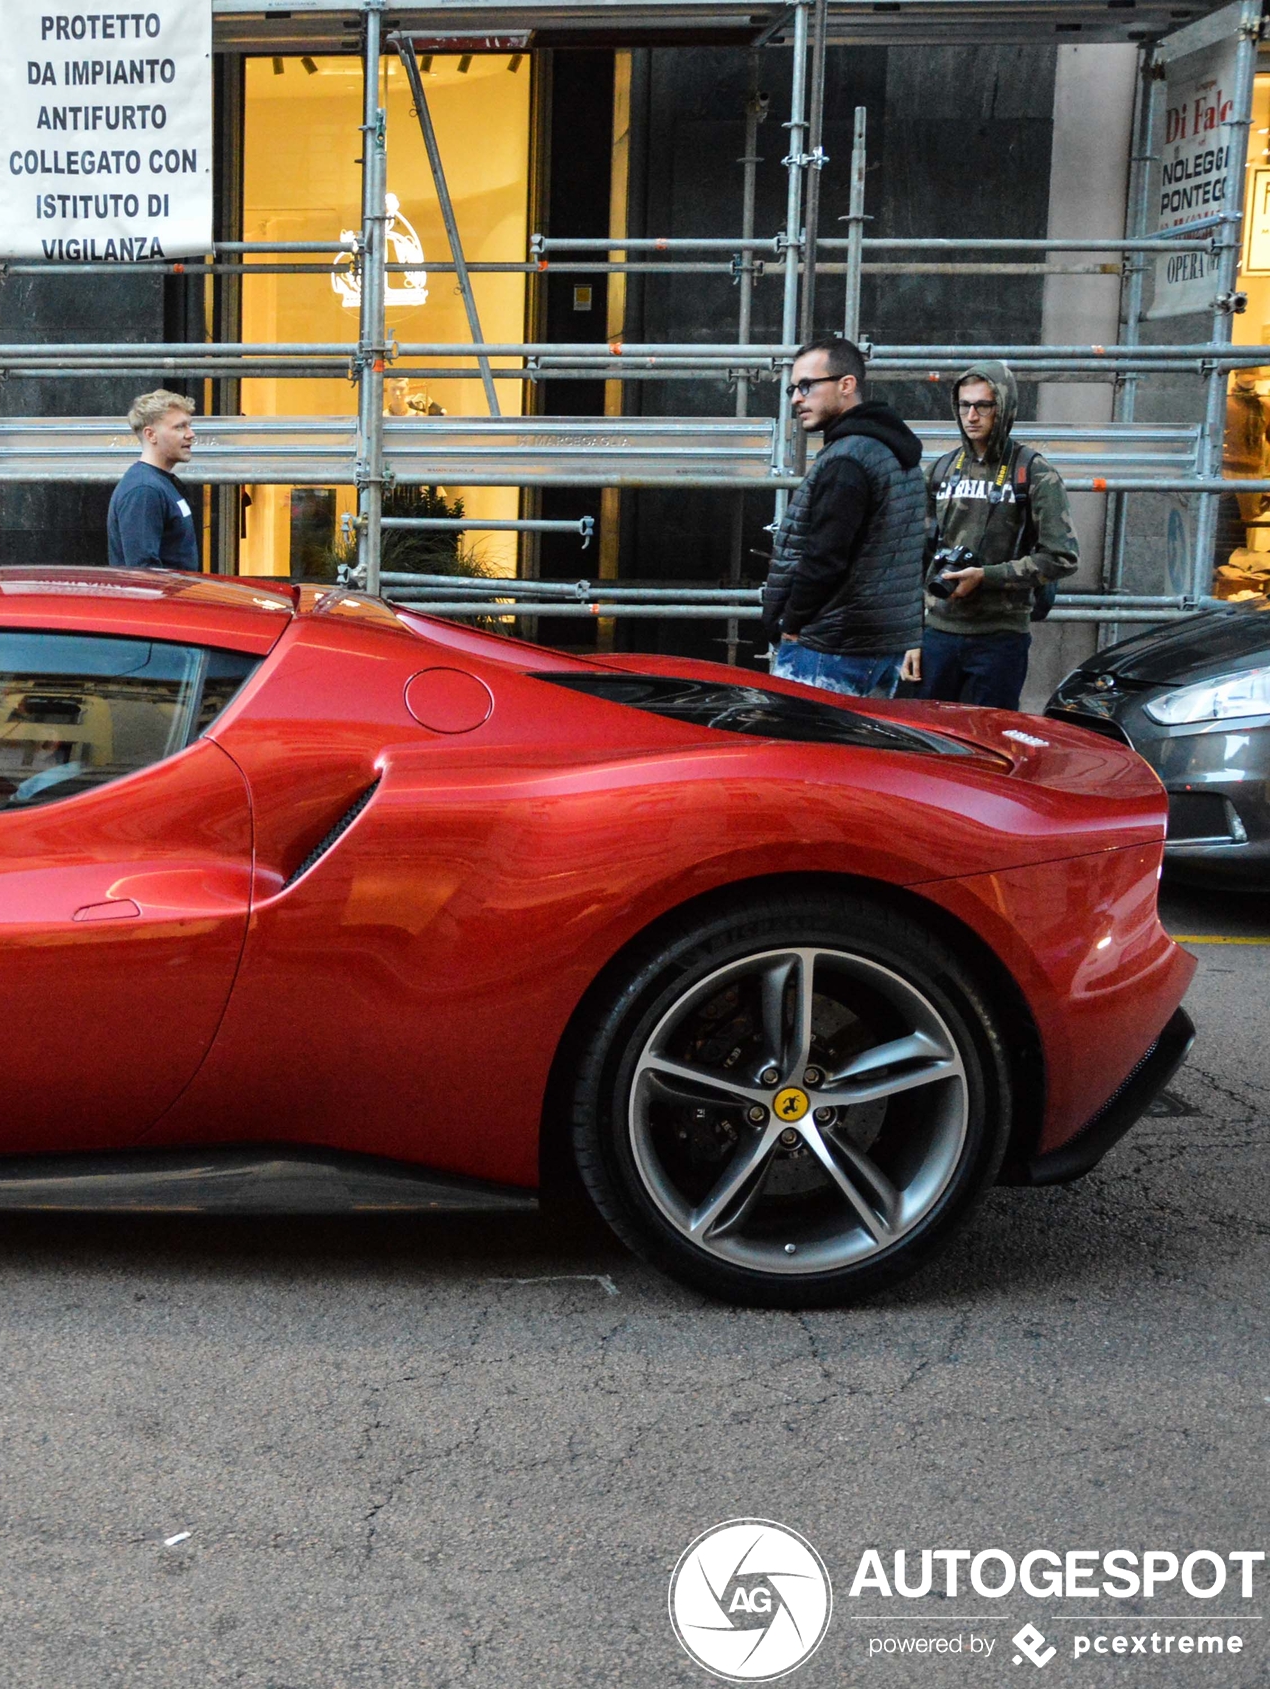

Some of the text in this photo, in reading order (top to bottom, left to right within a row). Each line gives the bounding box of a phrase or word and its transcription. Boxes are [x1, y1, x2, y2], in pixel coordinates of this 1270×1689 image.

[41, 13, 161, 41] PROTETTO
[27, 58, 176, 86] DA IMPIANTO
[37, 104, 167, 131] ANTIFURTO
[1165, 103, 1187, 145] Di
[9, 149, 197, 175] COLLEGATO CON
[36, 193, 169, 219] ISTITUTO DI
[41, 236, 165, 261] VIGILANZA
